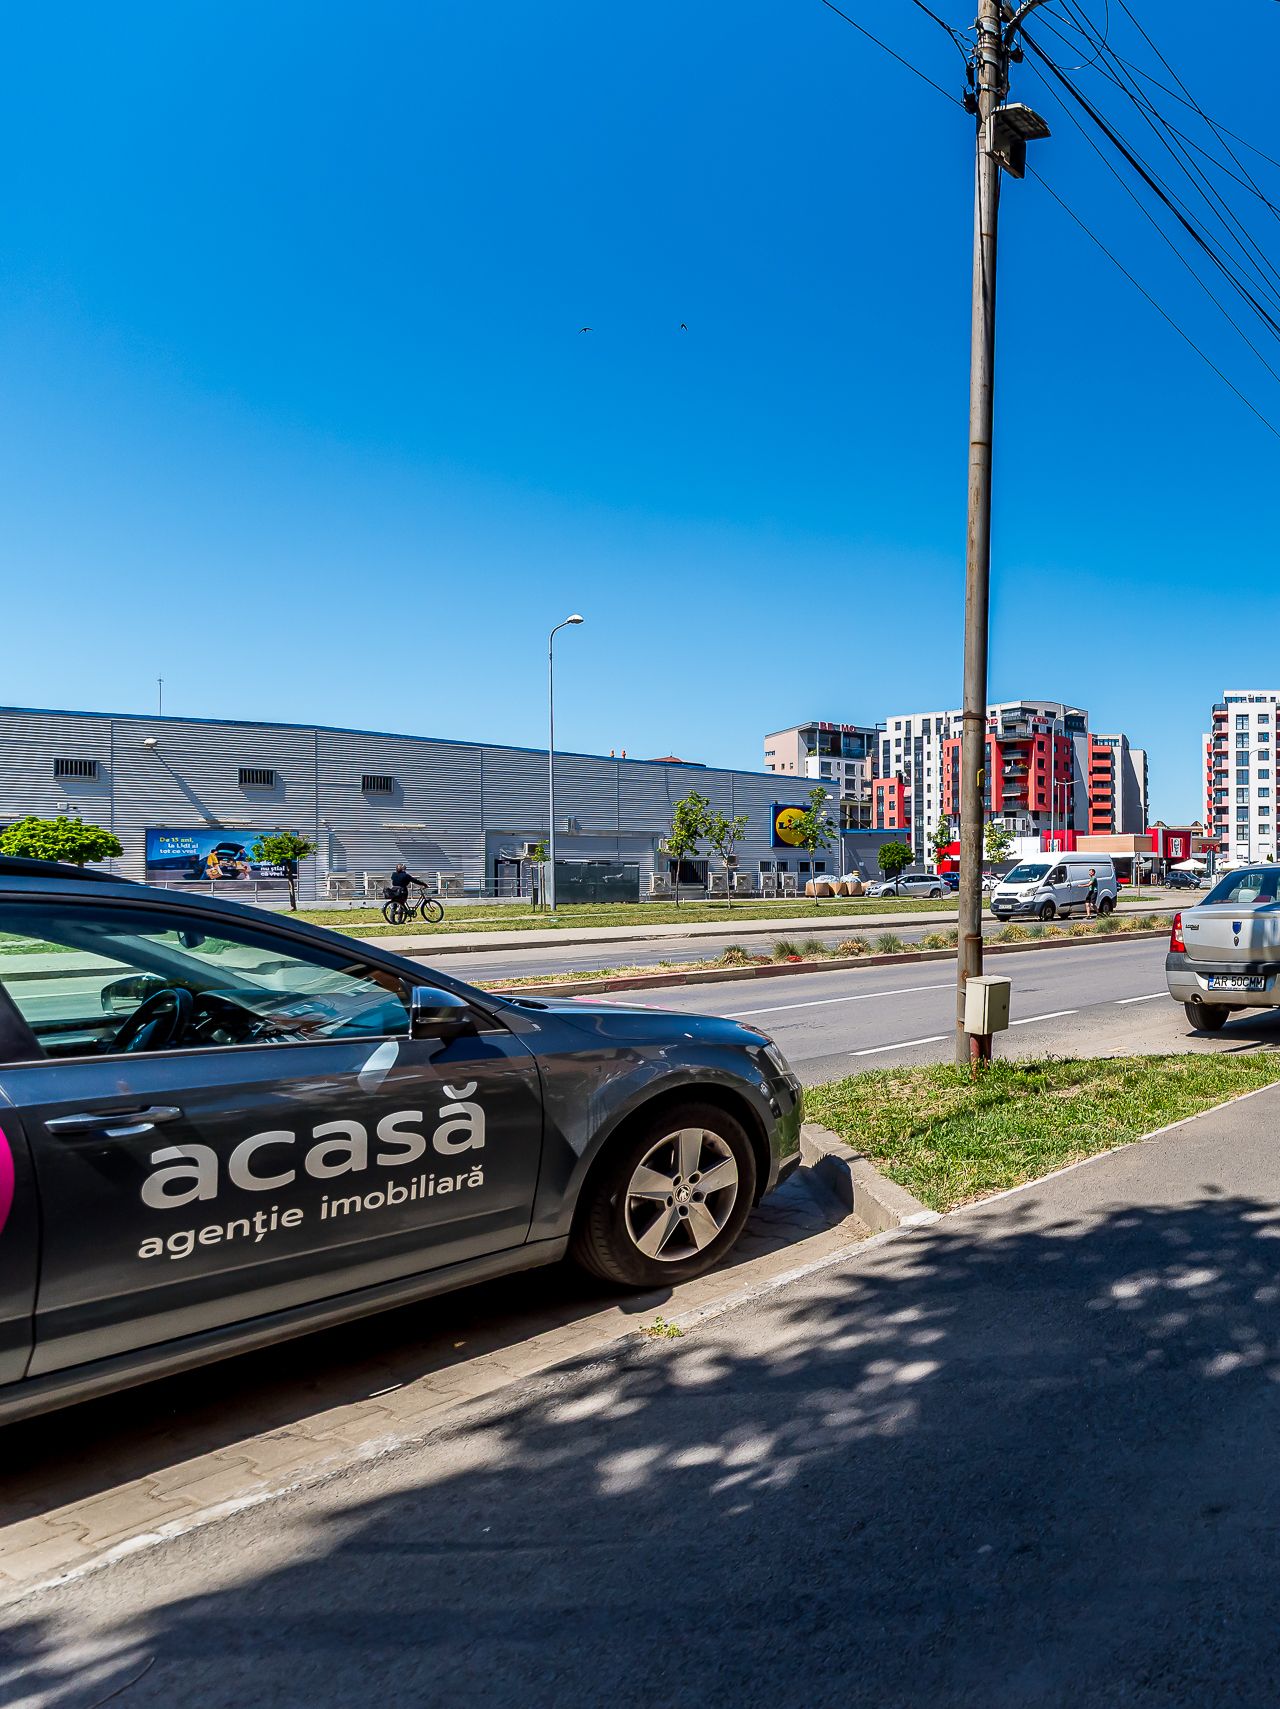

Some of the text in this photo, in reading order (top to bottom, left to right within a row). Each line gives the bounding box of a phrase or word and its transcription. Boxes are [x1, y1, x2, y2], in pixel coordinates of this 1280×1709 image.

[1213, 975, 1229, 987] AR
[141, 1081, 486, 1210] acasă
[138, 1164, 484, 1260] agenție imobiliară
